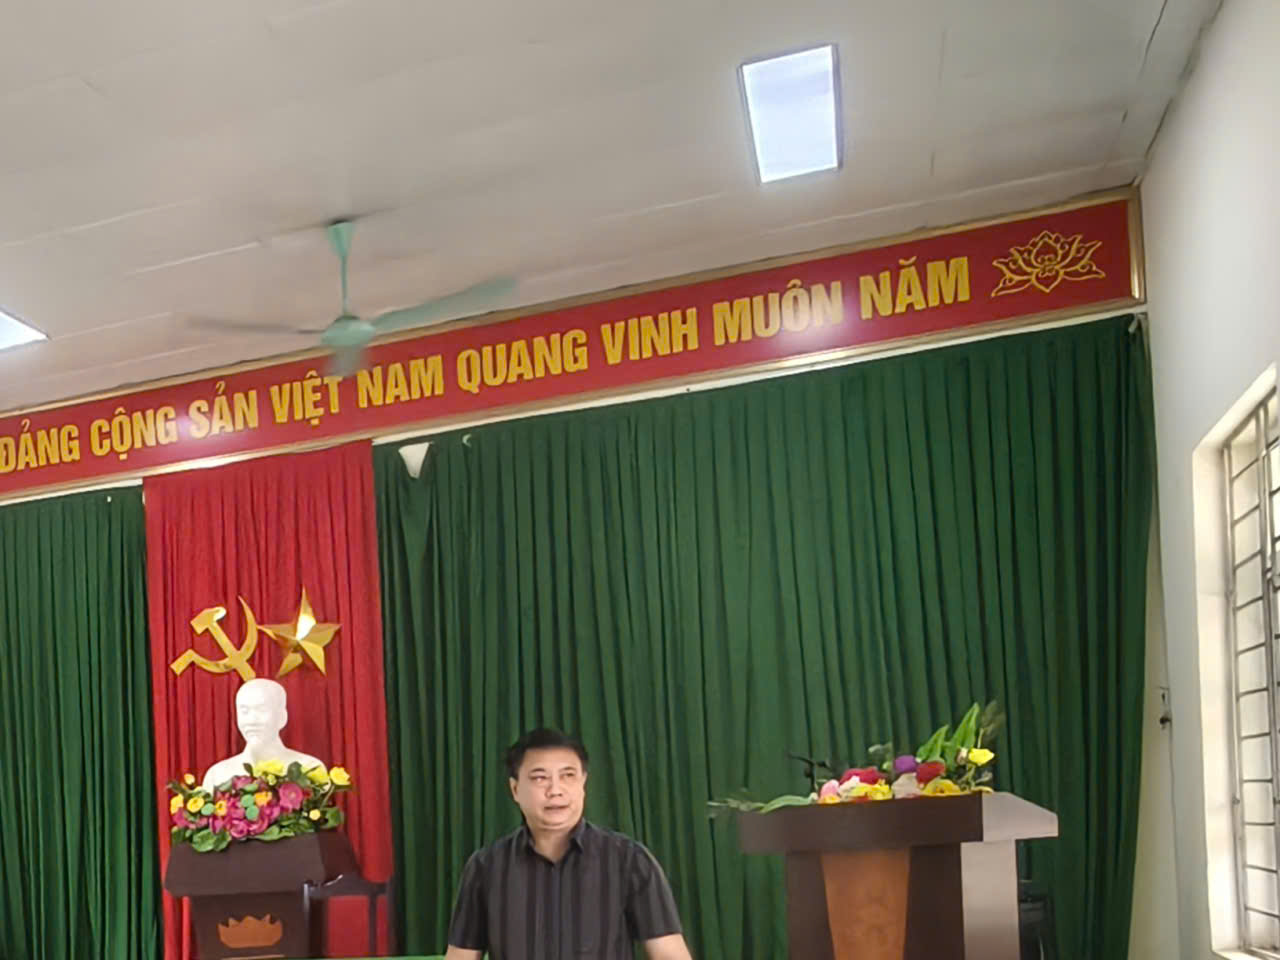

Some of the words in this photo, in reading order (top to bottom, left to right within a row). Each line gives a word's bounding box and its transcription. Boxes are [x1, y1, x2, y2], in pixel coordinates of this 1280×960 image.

[90, 407, 177, 460] CỘNG
[188, 381, 259, 439] SẢN
[270, 370, 343, 425] VIỆT
[356, 354, 444, 408] NAM
[457, 329, 589, 394] QUANG
[601, 307, 699, 365] VINH
[713, 279, 844, 346] MUÔN
[859, 255, 970, 320] NĂM
